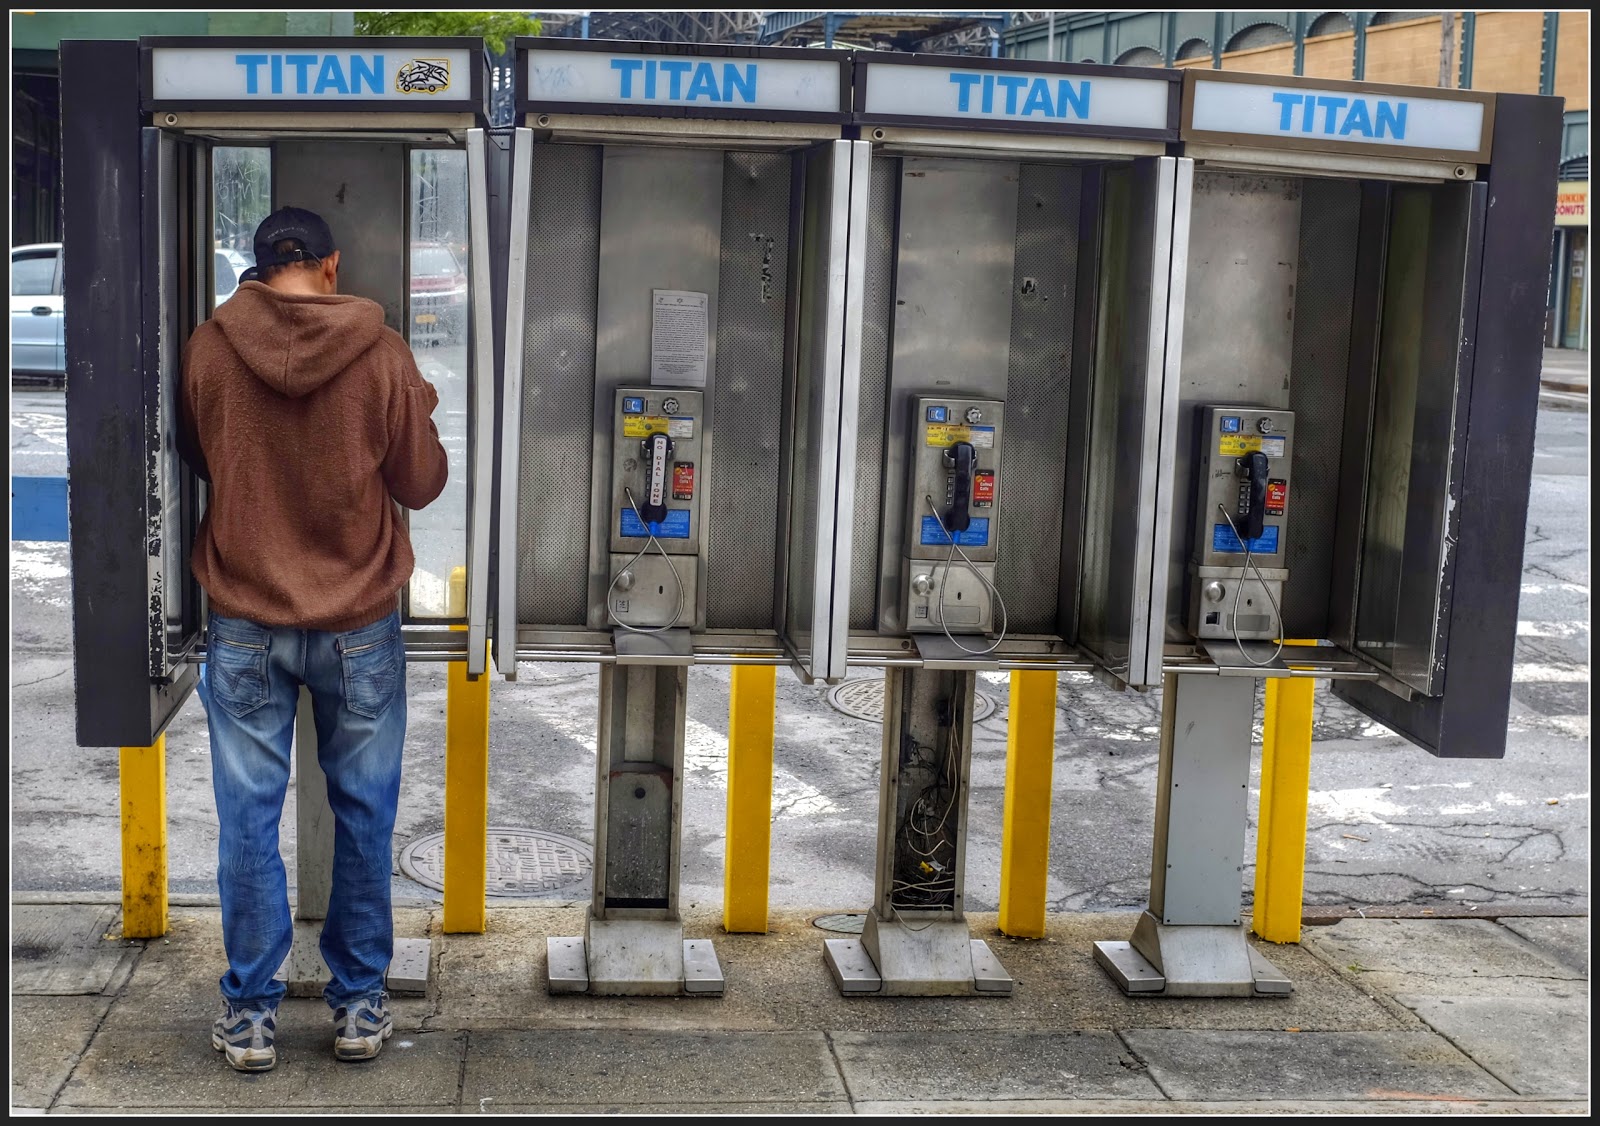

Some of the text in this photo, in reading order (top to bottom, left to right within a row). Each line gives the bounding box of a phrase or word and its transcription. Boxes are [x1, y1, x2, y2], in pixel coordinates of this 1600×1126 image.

[236, 54, 385, 95] TITAN
[611, 59, 757, 103] TITAN
[950, 73, 1091, 119] TITAN
[1272, 92, 1408, 139] TITAN
[656, 440, 663, 450] NO
[652, 482, 660, 504] TONE
